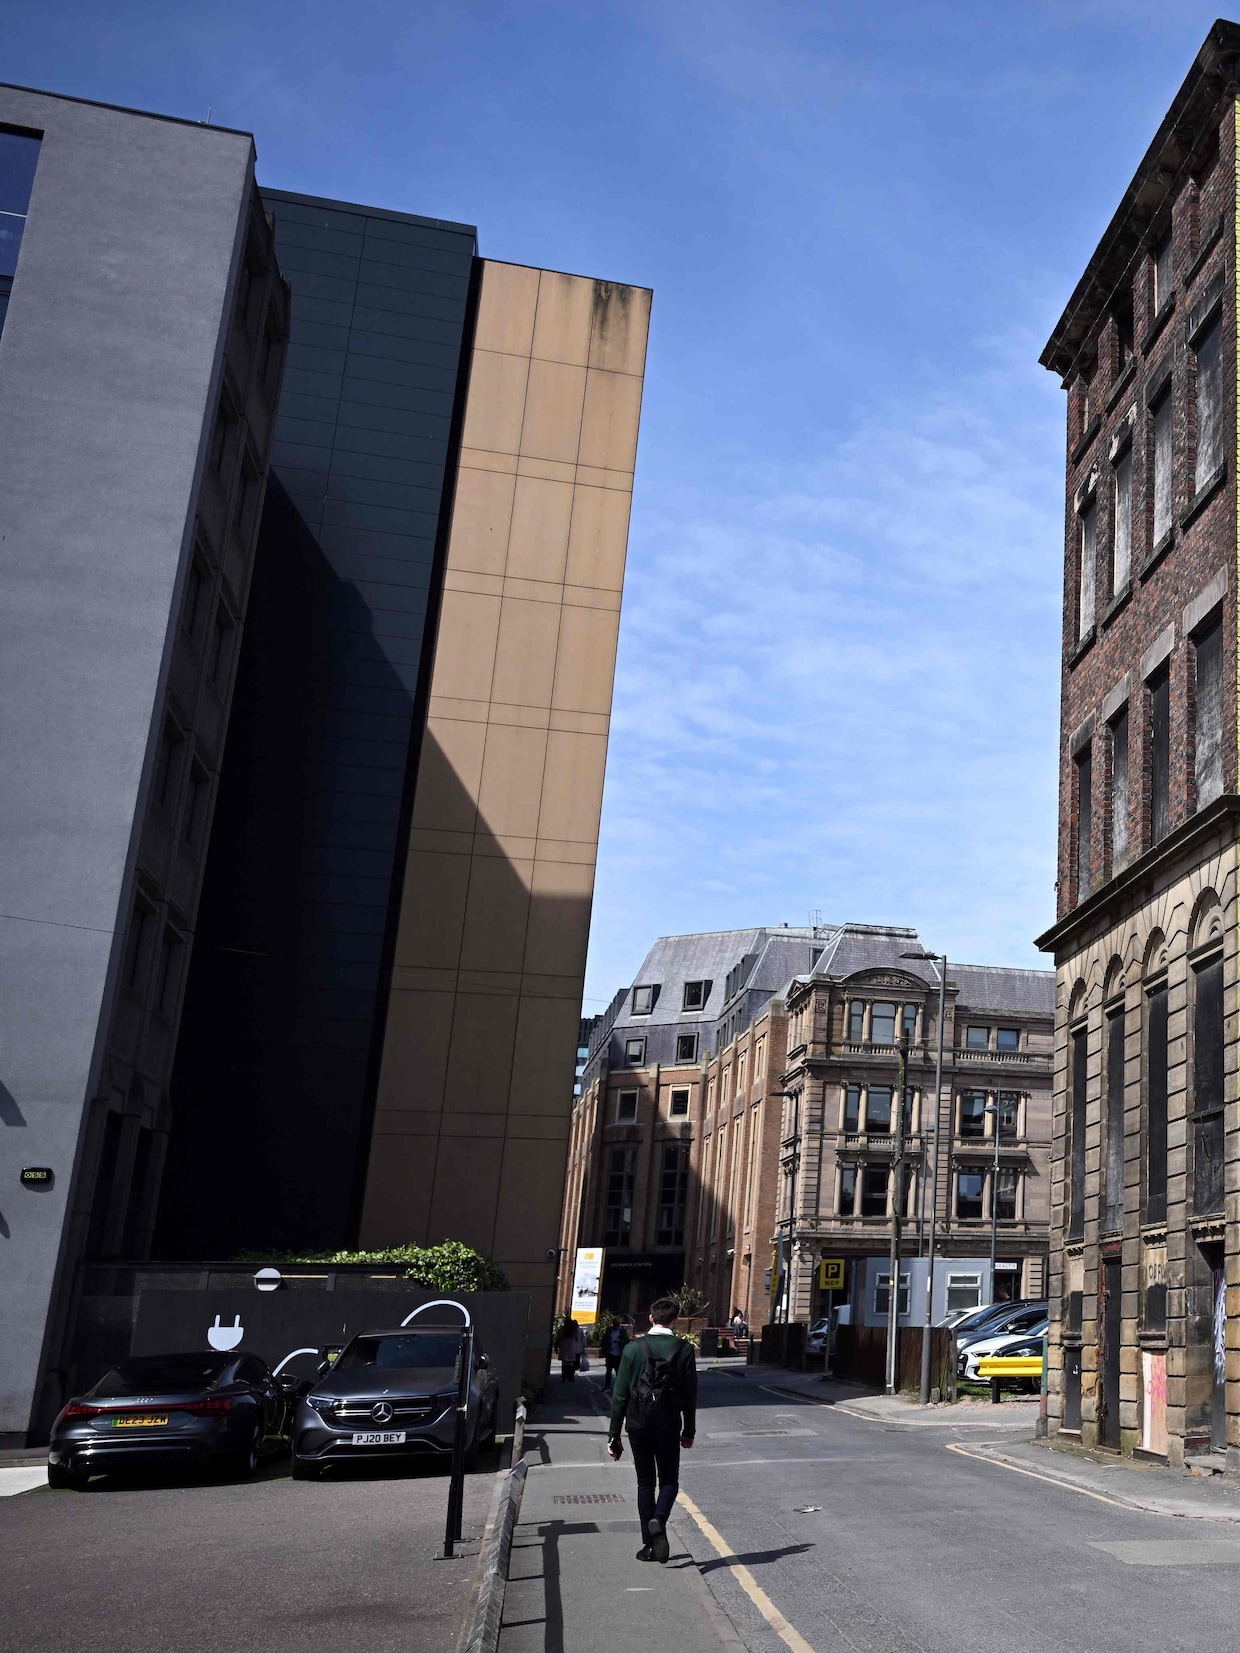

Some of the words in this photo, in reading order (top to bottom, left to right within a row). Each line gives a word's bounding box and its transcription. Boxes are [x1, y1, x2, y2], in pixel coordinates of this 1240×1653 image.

[827, 1264, 838, 1277] P
[119, 1415, 145, 1425] DE23
[356, 1434, 381, 1444] PJ20
[383, 1433, 402, 1443] BEY
